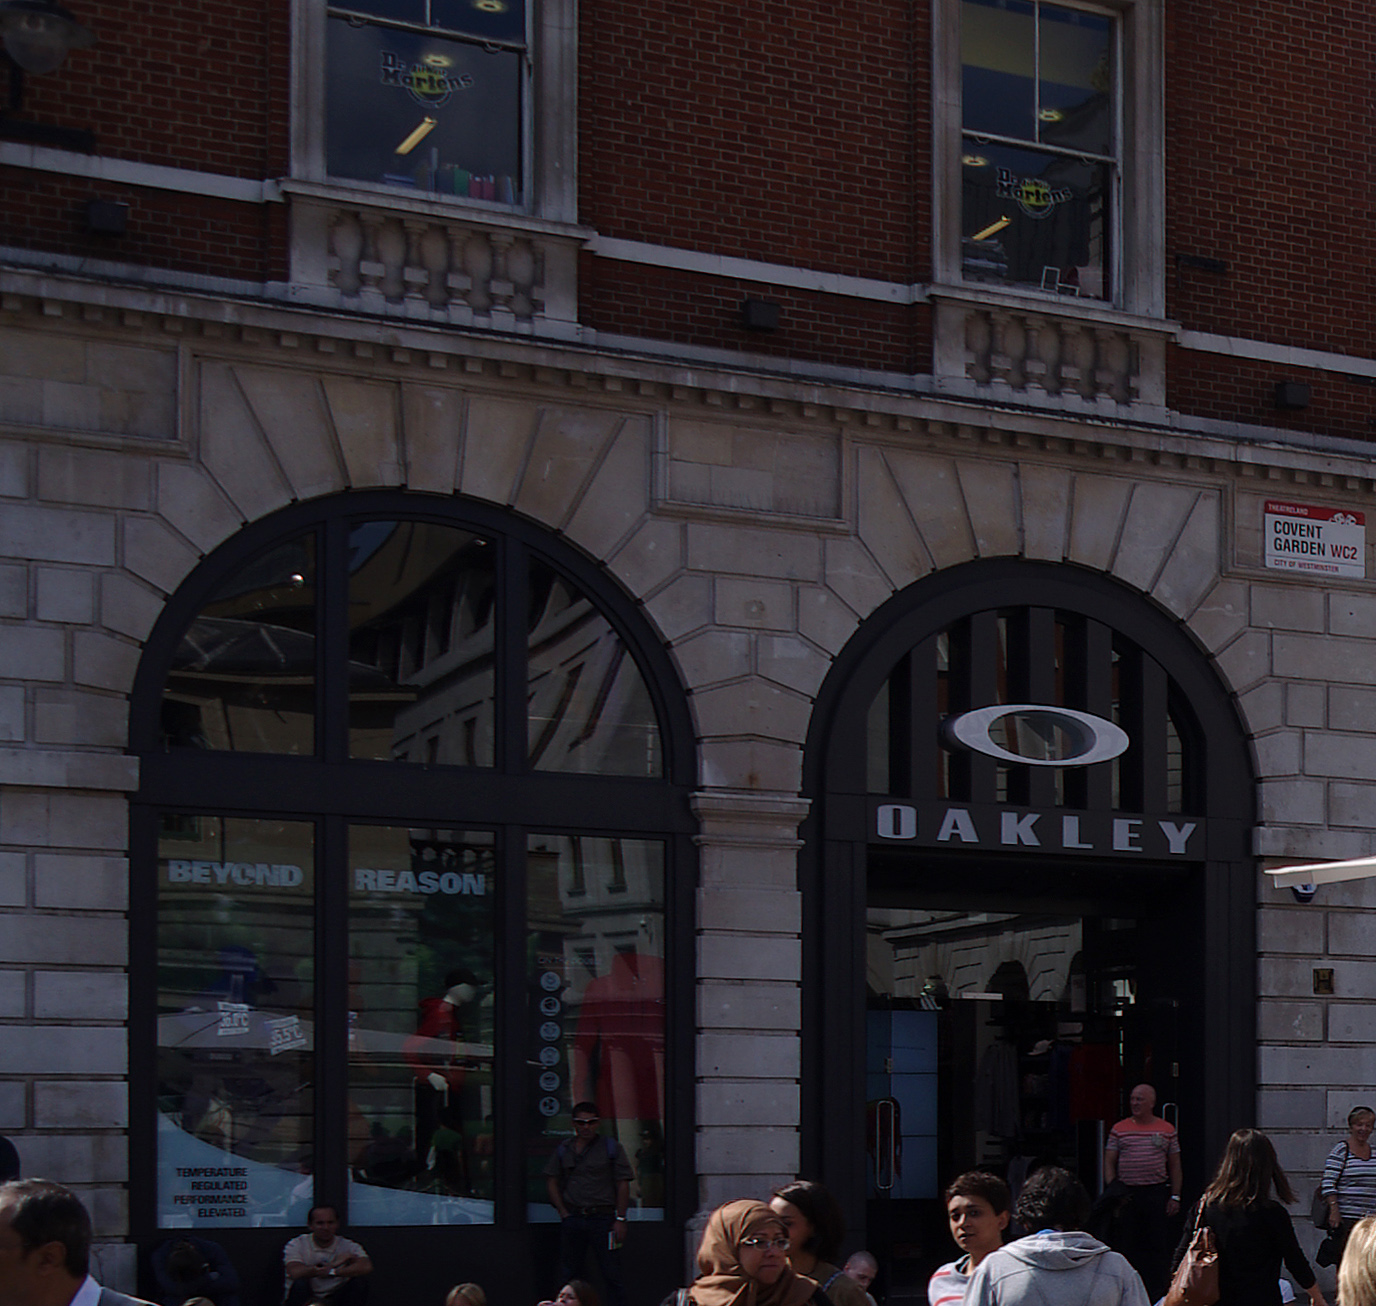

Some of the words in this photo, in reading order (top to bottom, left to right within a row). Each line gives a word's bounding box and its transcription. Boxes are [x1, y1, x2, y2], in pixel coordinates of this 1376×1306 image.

[381, 67, 474, 91] Martens
[996, 181, 1073, 204] Martens
[1273, 520, 1323, 539] COVENT
[1273, 537, 1326, 556] GARDEN
[1330, 544, 1357, 560] WC2
[1273, 559, 1287, 567] CITY
[1298, 562, 1339, 572] WESTMINSTER
[877, 804, 1197, 854] OAKLEY
[168, 860, 303, 887] BEYOND
[355, 869, 485, 895] REASON
[176, 1167, 249, 1177] TEMPERATURE
[191, 1181, 248, 1191] REGULATED
[174, 1194, 248, 1205] PERFORMANCE
